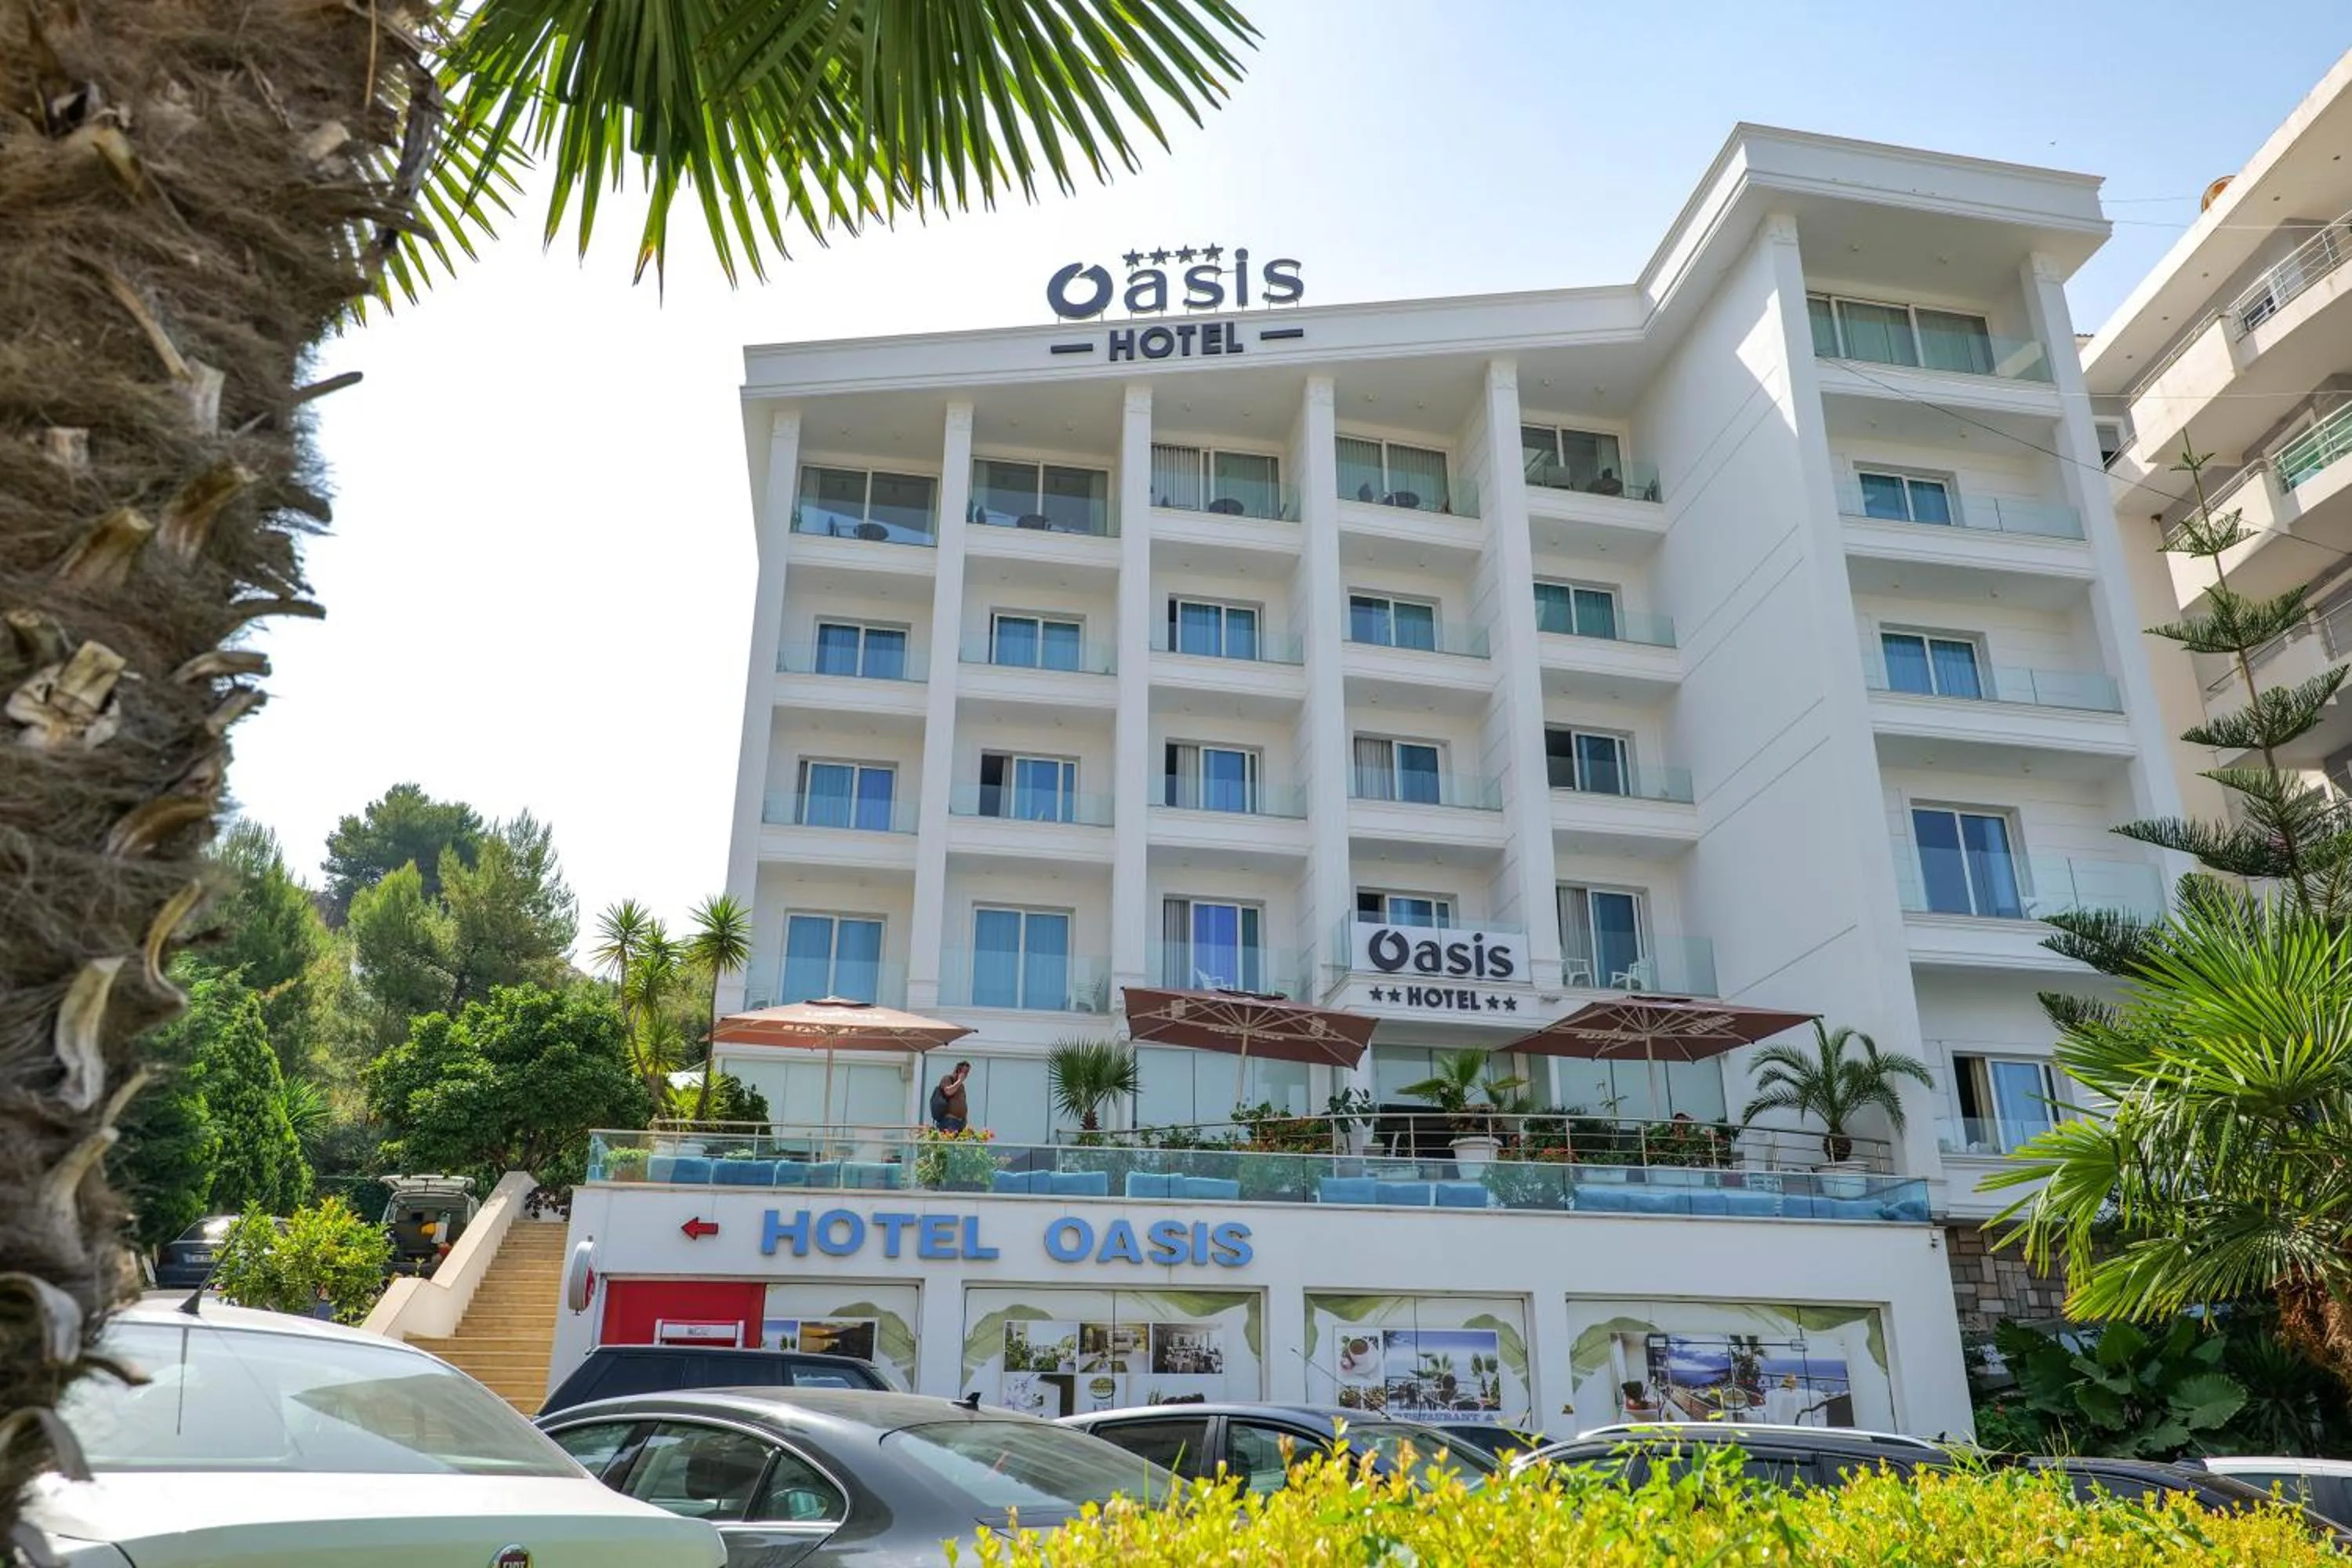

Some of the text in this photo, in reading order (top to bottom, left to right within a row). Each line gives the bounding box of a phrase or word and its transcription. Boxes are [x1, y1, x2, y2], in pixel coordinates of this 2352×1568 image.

[1047, 248, 1304, 320] Oasis
[1109, 321, 1244, 361] HOTEL
[1368, 929, 1514, 978] Oasis
[1407, 986, 1481, 1011] HOTEL
[760, 1209, 1254, 1268] HOTEL OASIS
